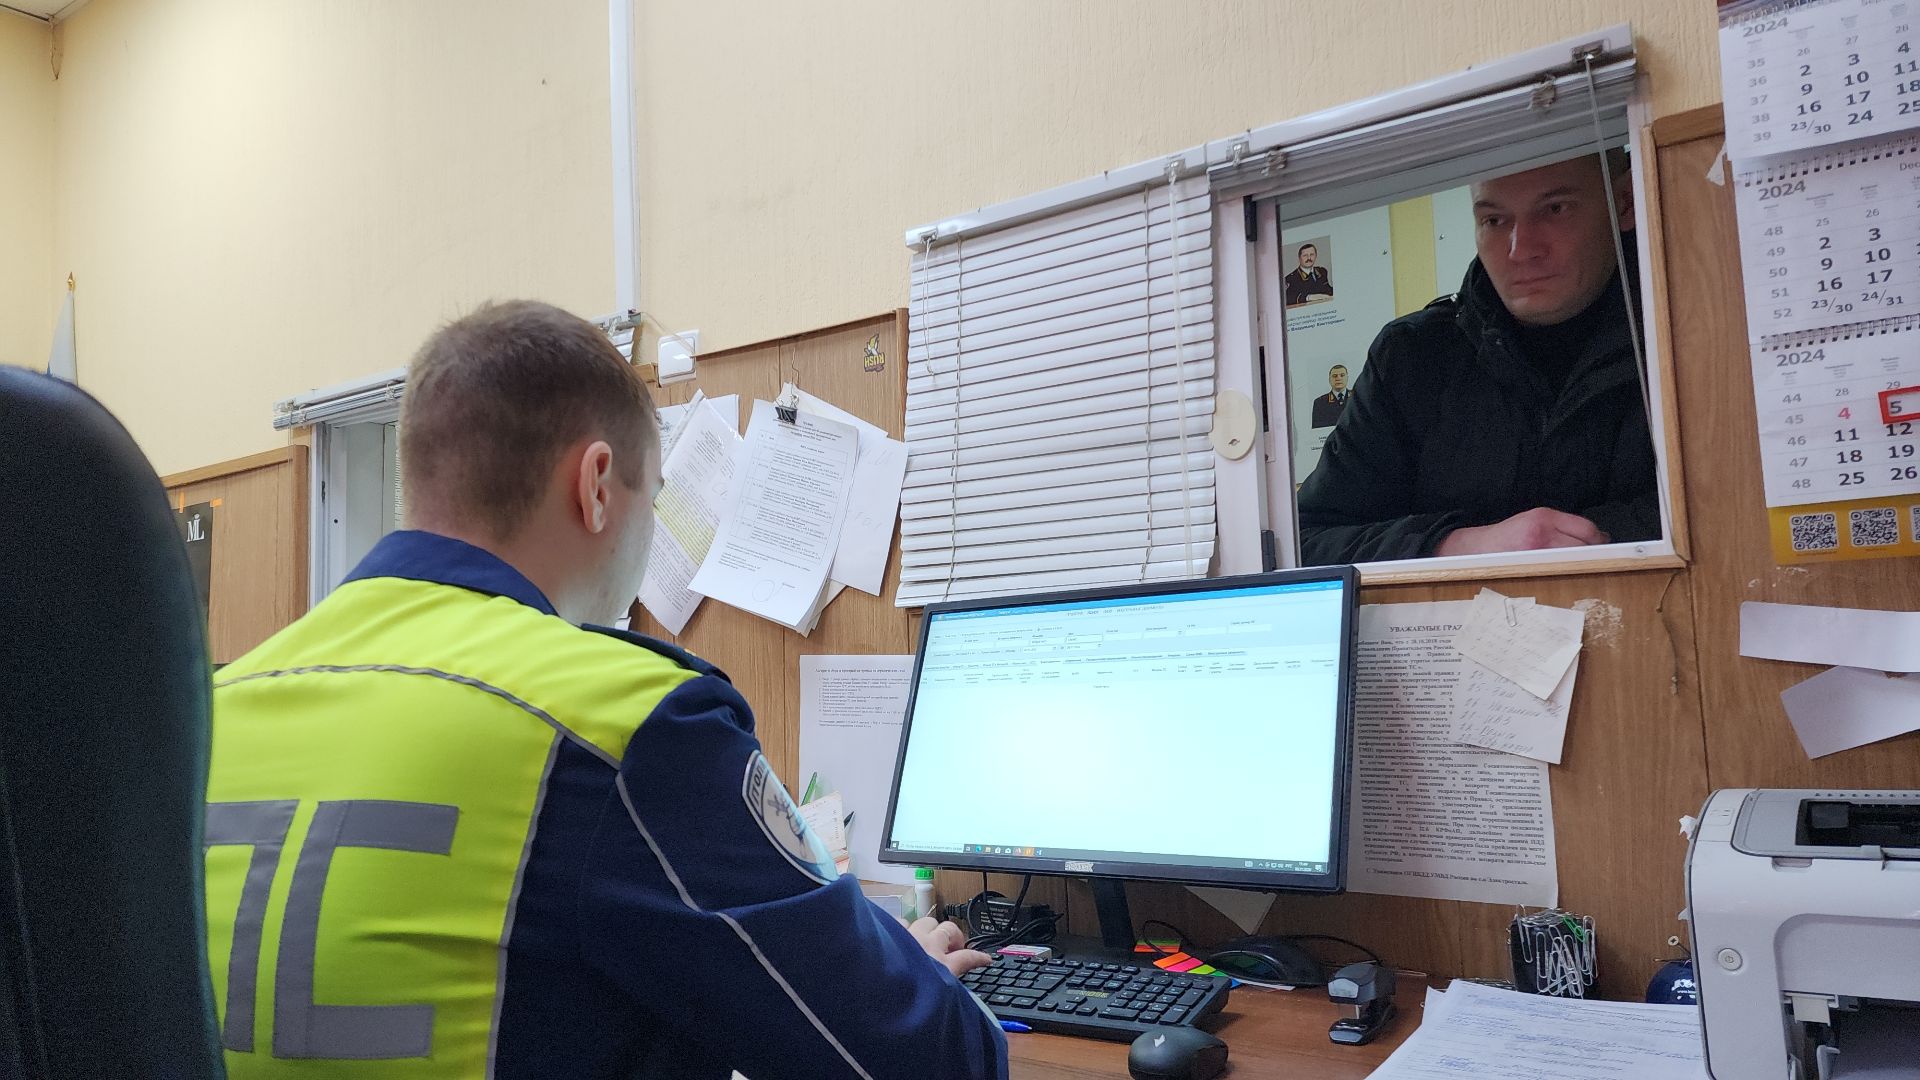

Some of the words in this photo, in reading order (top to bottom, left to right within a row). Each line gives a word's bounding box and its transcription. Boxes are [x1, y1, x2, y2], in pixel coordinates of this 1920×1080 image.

[1743, 17, 1788, 37] 2024
[1748, 58, 1765, 70] 35
[1749, 76, 1767, 88] 36
[1800, 64, 1811, 77] 2
[1848, 53, 1860, 66] 3
[1898, 42, 1911, 54] 4
[1751, 95, 1768, 106] 37
[1801, 83, 1813, 97] 9
[1844, 71, 1869, 87] 10
[1893, 60, 1920, 76] 11
[1752, 113, 1770, 124] 38
[1797, 101, 1822, 116] 16
[1846, 90, 1871, 106] 17
[1896, 79, 1920, 96] 18
[1753, 131, 1771, 142] 39
[1790, 119, 1832, 135] 23/30
[1847, 110, 1873, 126] 24
[1898, 100, 1920, 115] 25
[1758, 180, 1806, 201] 2024
[1764, 226, 1783, 236] 48
[1816, 217, 1830, 227] 25
[1766, 246, 1786, 257] 49
[1819, 237, 1832, 250] 2
[1868, 227, 1882, 241] 3
[1769, 266, 1788, 278] 50
[1821, 258, 1833, 271] 9
[1865, 247, 1891, 264] 10
[1771, 287, 1790, 299] 51
[1817, 277, 1843, 293] 16
[1867, 269, 1893, 285] 17
[1773, 308, 1793, 319] 52
[1811, 297, 1853, 314] 23/30
[1861, 289, 1904, 306] 24/31
[1776, 348, 1826, 367] 2024
[1782, 393, 1802, 404] 44
[1835, 388, 1849, 397] 28
[1785, 414, 1804, 425] 45
[1838, 407, 1851, 420] 4
[1890, 400, 1902, 414] 5
[1787, 435, 1807, 447] 46
[1834, 428, 1860, 443] 11
[1886, 422, 1913, 437] 12
[1789, 456, 1808, 468] 47
[1836, 449, 1863, 464] 18
[1888, 444, 1915, 459] 19
[1792, 478, 1811, 489] 48
[1838, 471, 1865, 486] 25
[1890, 466, 1918, 481] 26
